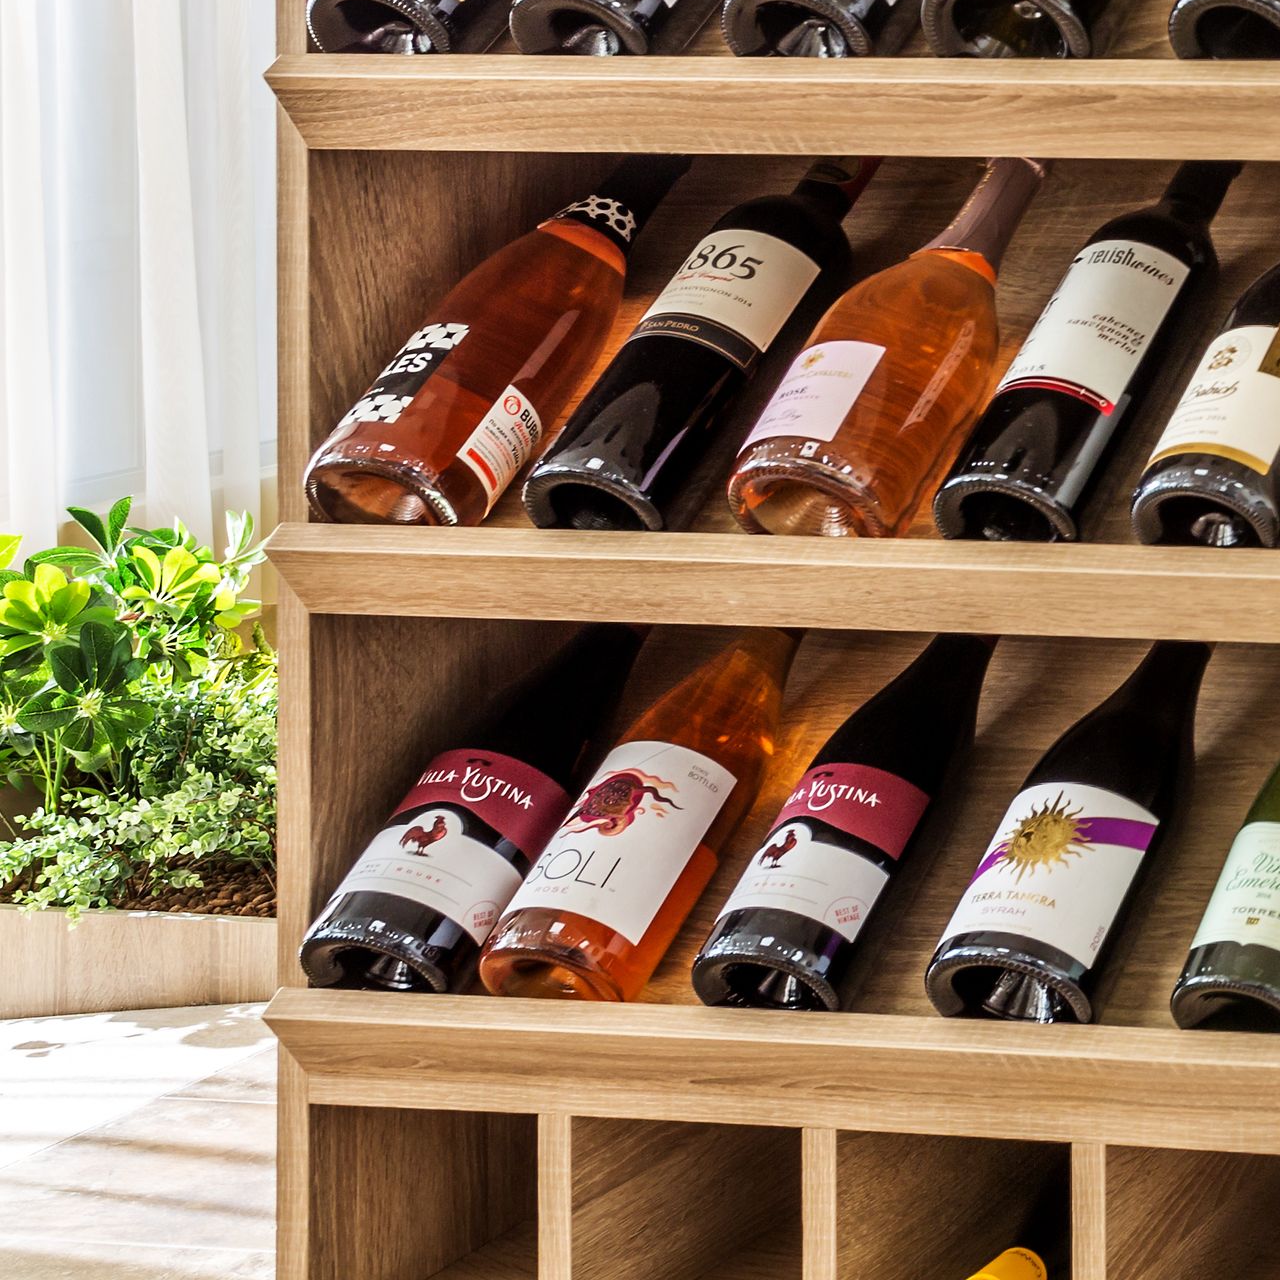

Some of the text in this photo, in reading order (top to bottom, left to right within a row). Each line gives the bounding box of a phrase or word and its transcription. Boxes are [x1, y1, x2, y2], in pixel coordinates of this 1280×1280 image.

[664, 320, 700, 332] PEDRO
[1092, 313, 1146, 340] cabernet
[1097, 333, 1137, 355] merlot
[416, 766, 535, 810] VILLA YUSTINA
[687, 771, 719, 794] BOTTLED
[807, 779, 883, 811] YUSTINA
[526, 848, 622, 889] SOLI
[971, 890, 1058, 909] TERRA TANGRA
[834, 904, 861, 918] BEST OF
[836, 912, 862, 925] VINTAGE
[981, 906, 1026, 917] SYRAH
